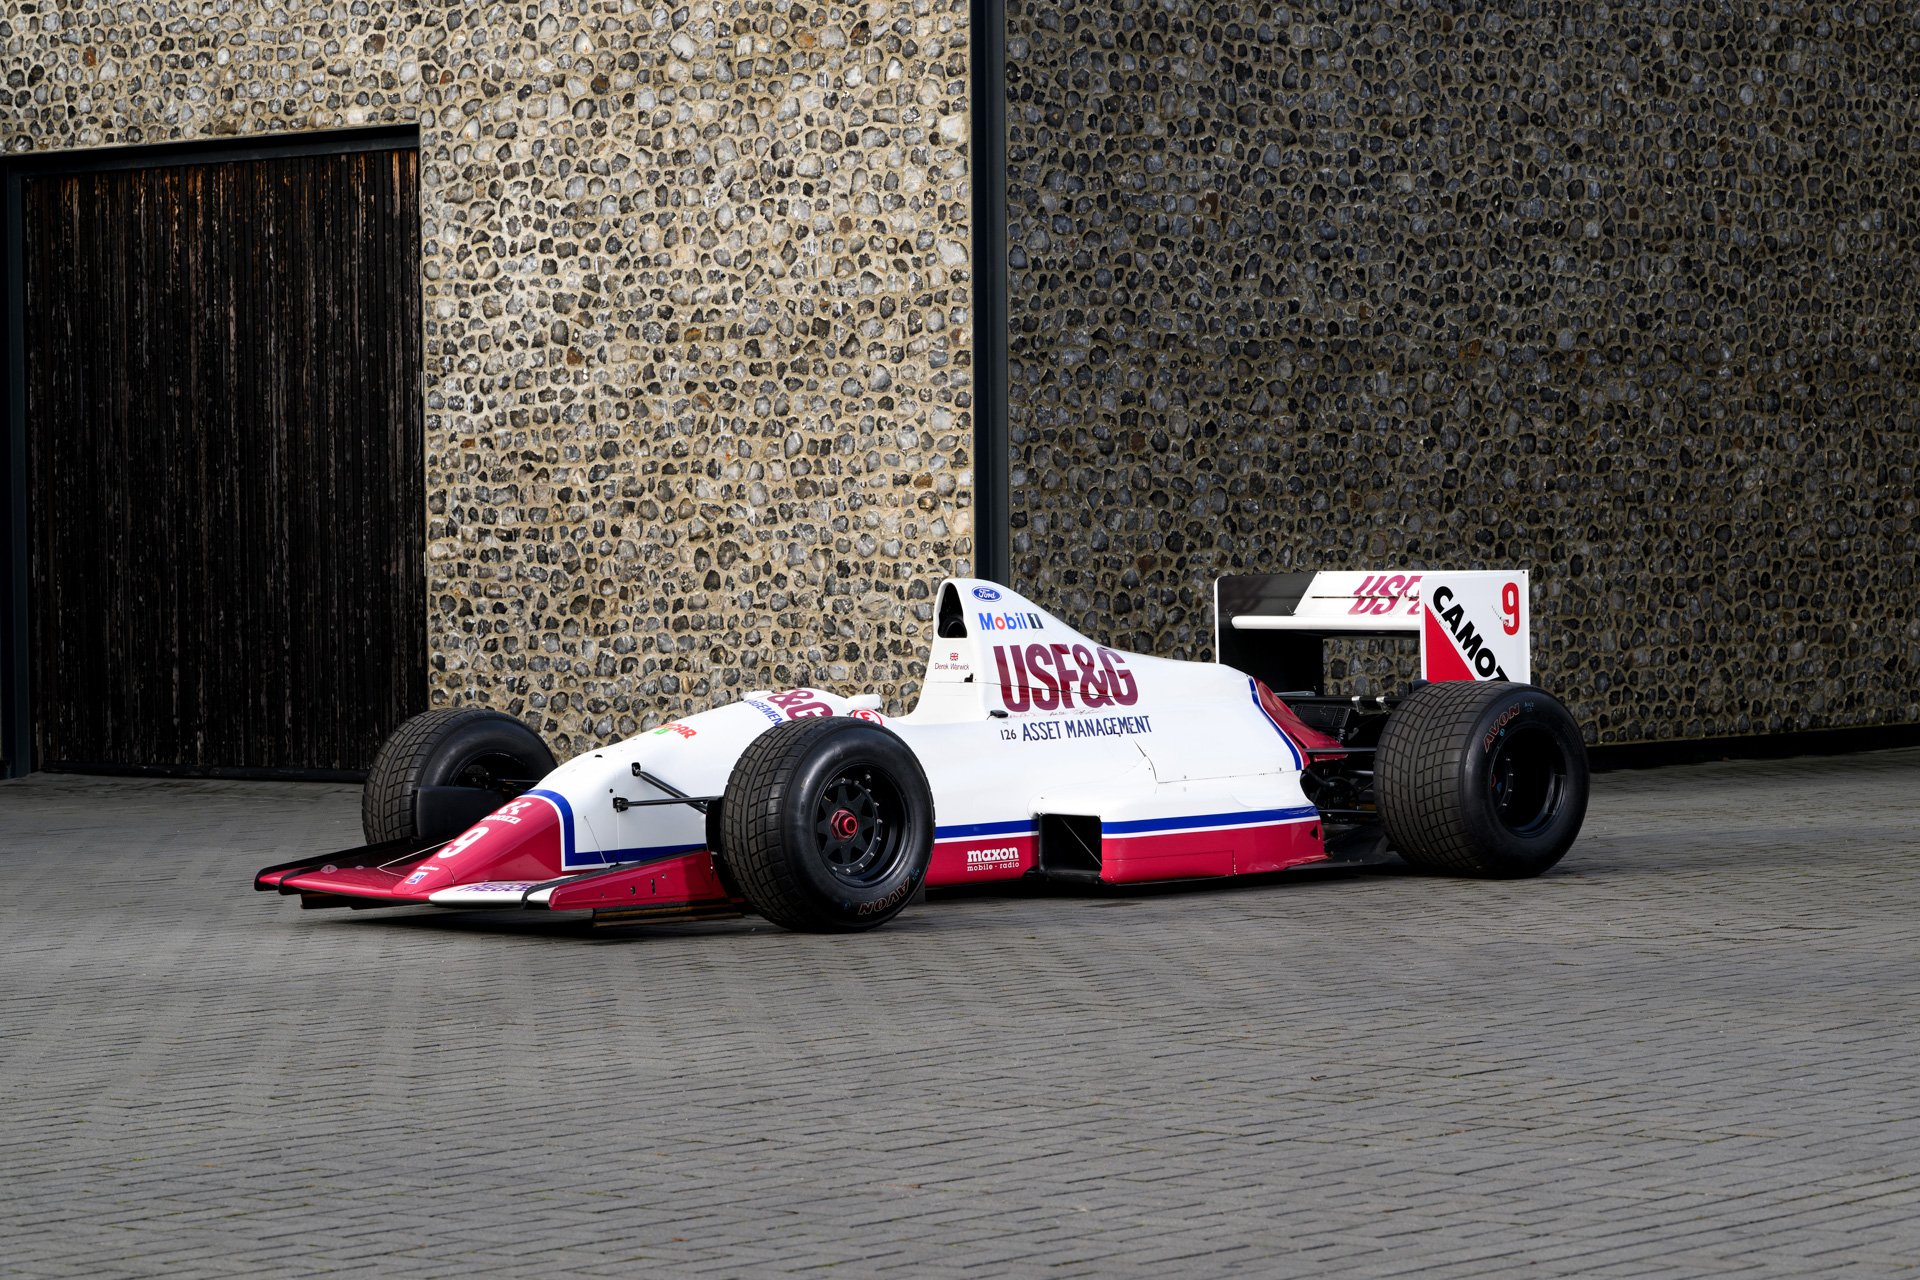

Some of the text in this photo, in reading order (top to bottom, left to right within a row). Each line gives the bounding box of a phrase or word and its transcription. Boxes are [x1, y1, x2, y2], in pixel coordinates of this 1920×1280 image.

[978, 612, 1043, 630] Mobil 1
[1501, 582, 1520, 636] 9
[934, 662, 970, 670] Derek Warwick
[993, 643, 1139, 713] USF&G
[1000, 728, 1017, 741] 126
[1022, 715, 1152, 742] ASSET MANAGEMENT
[1483, 702, 1520, 754] AVON
[438, 826, 490, 858] 9
[967, 847, 1019, 863] maxon
[967, 864, 993, 872] mobile
[999, 861, 1020, 869] radio
[857, 876, 910, 916] AVON
